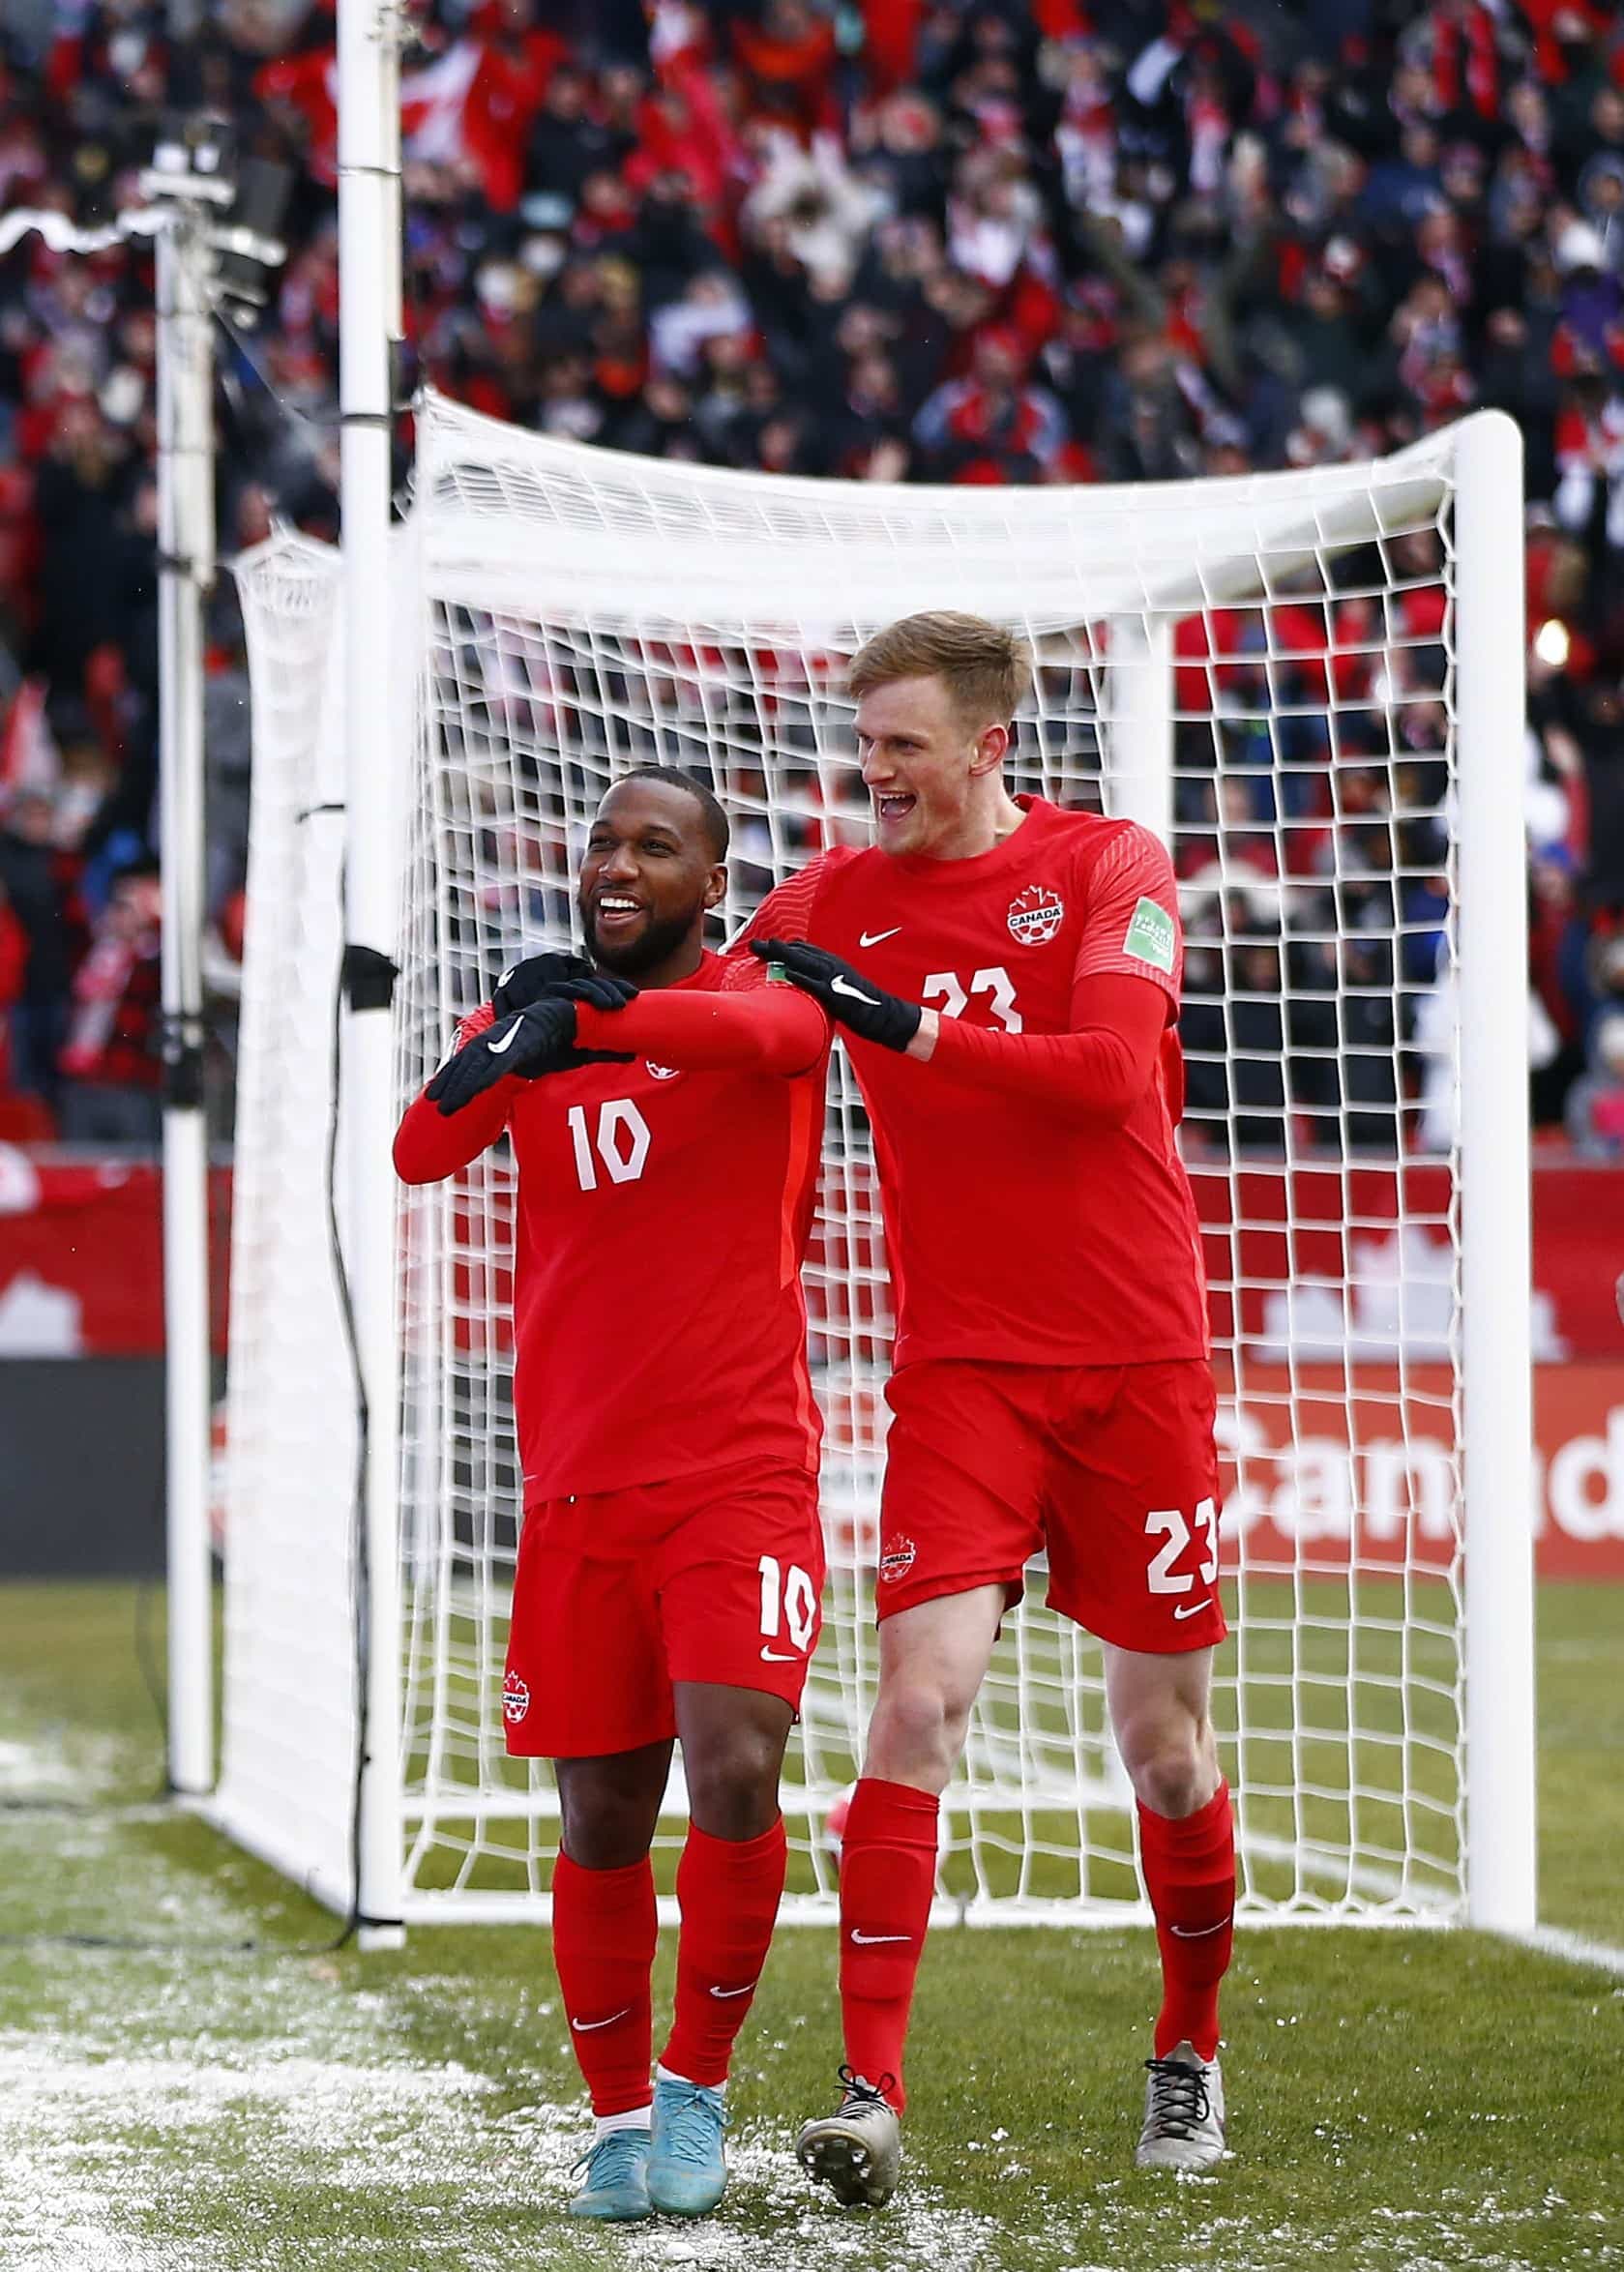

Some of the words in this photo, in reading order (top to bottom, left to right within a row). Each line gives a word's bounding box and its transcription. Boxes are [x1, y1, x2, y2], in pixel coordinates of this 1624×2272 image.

[1009, 907, 1061, 928] CANADA
[568, 1098, 651, 1191] 10
[1144, 1496, 1219, 1594] 23
[757, 1554, 816, 1653] 10
